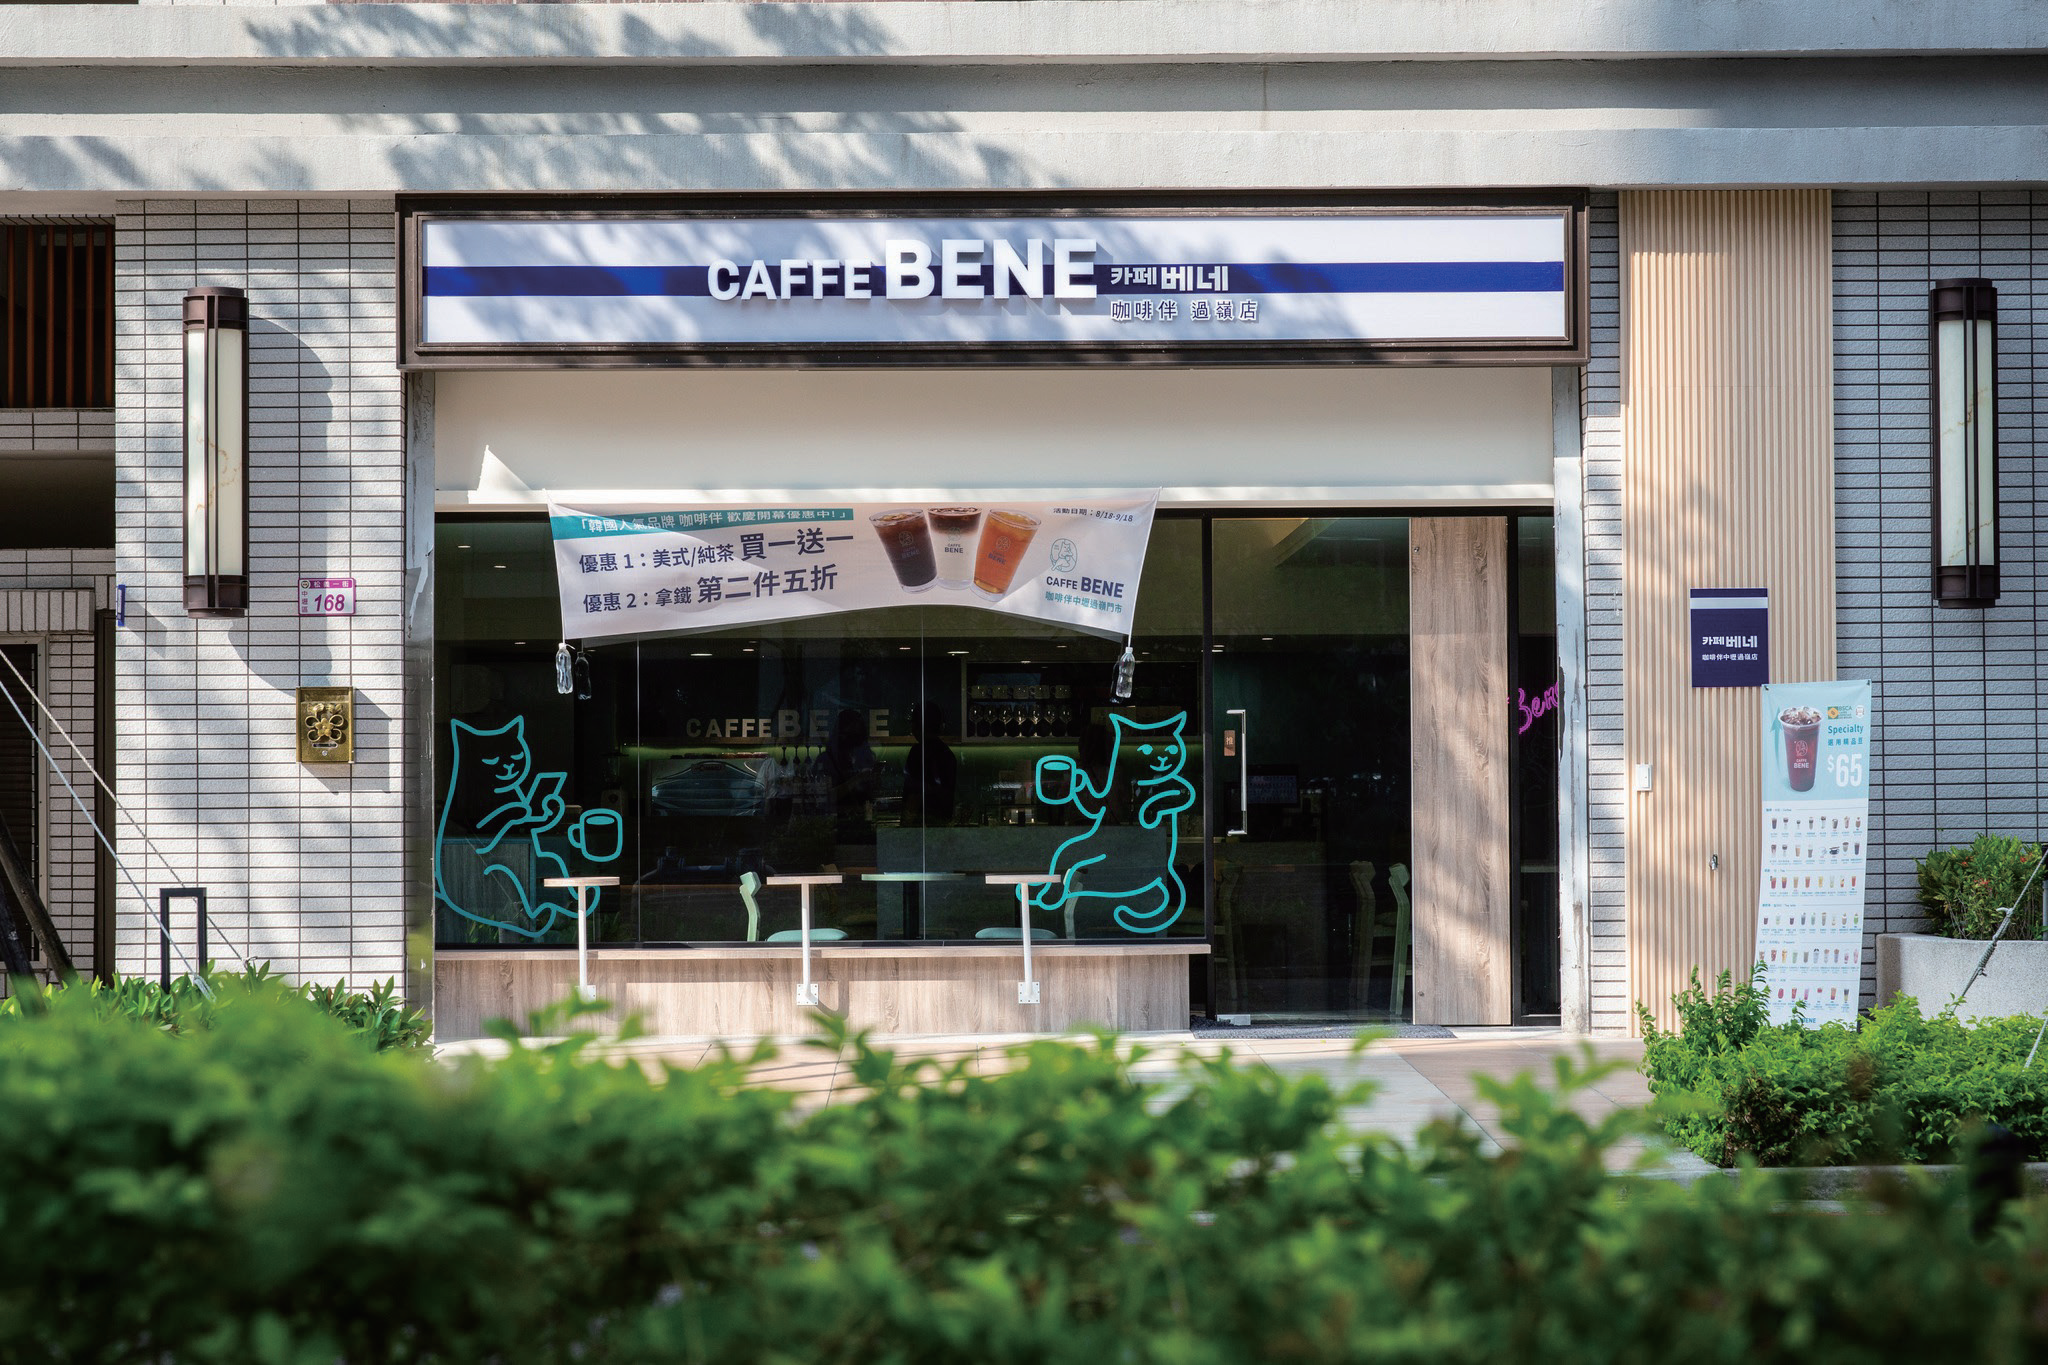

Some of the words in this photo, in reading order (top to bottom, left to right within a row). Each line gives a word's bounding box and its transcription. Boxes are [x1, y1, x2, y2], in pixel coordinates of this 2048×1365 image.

[707, 259, 872, 301] CAFFE
[885, 238, 1098, 300] BENE
[1111, 300, 1178, 320] 咖啡伴
[1191, 300, 1257, 320] 過嶺店
[740, 527, 853, 562] 買一送一
[697, 563, 838, 604] 第二件五折
[1046, 576, 1078, 590] CAFFE
[1081, 576, 1124, 598] BENE
[314, 593, 345, 612] 168
[686, 718, 772, 738] CAFFE
[778, 709, 890, 738] BEE
[1828, 724, 1864, 735] Specialty
[1827, 753, 1862, 787] $65
